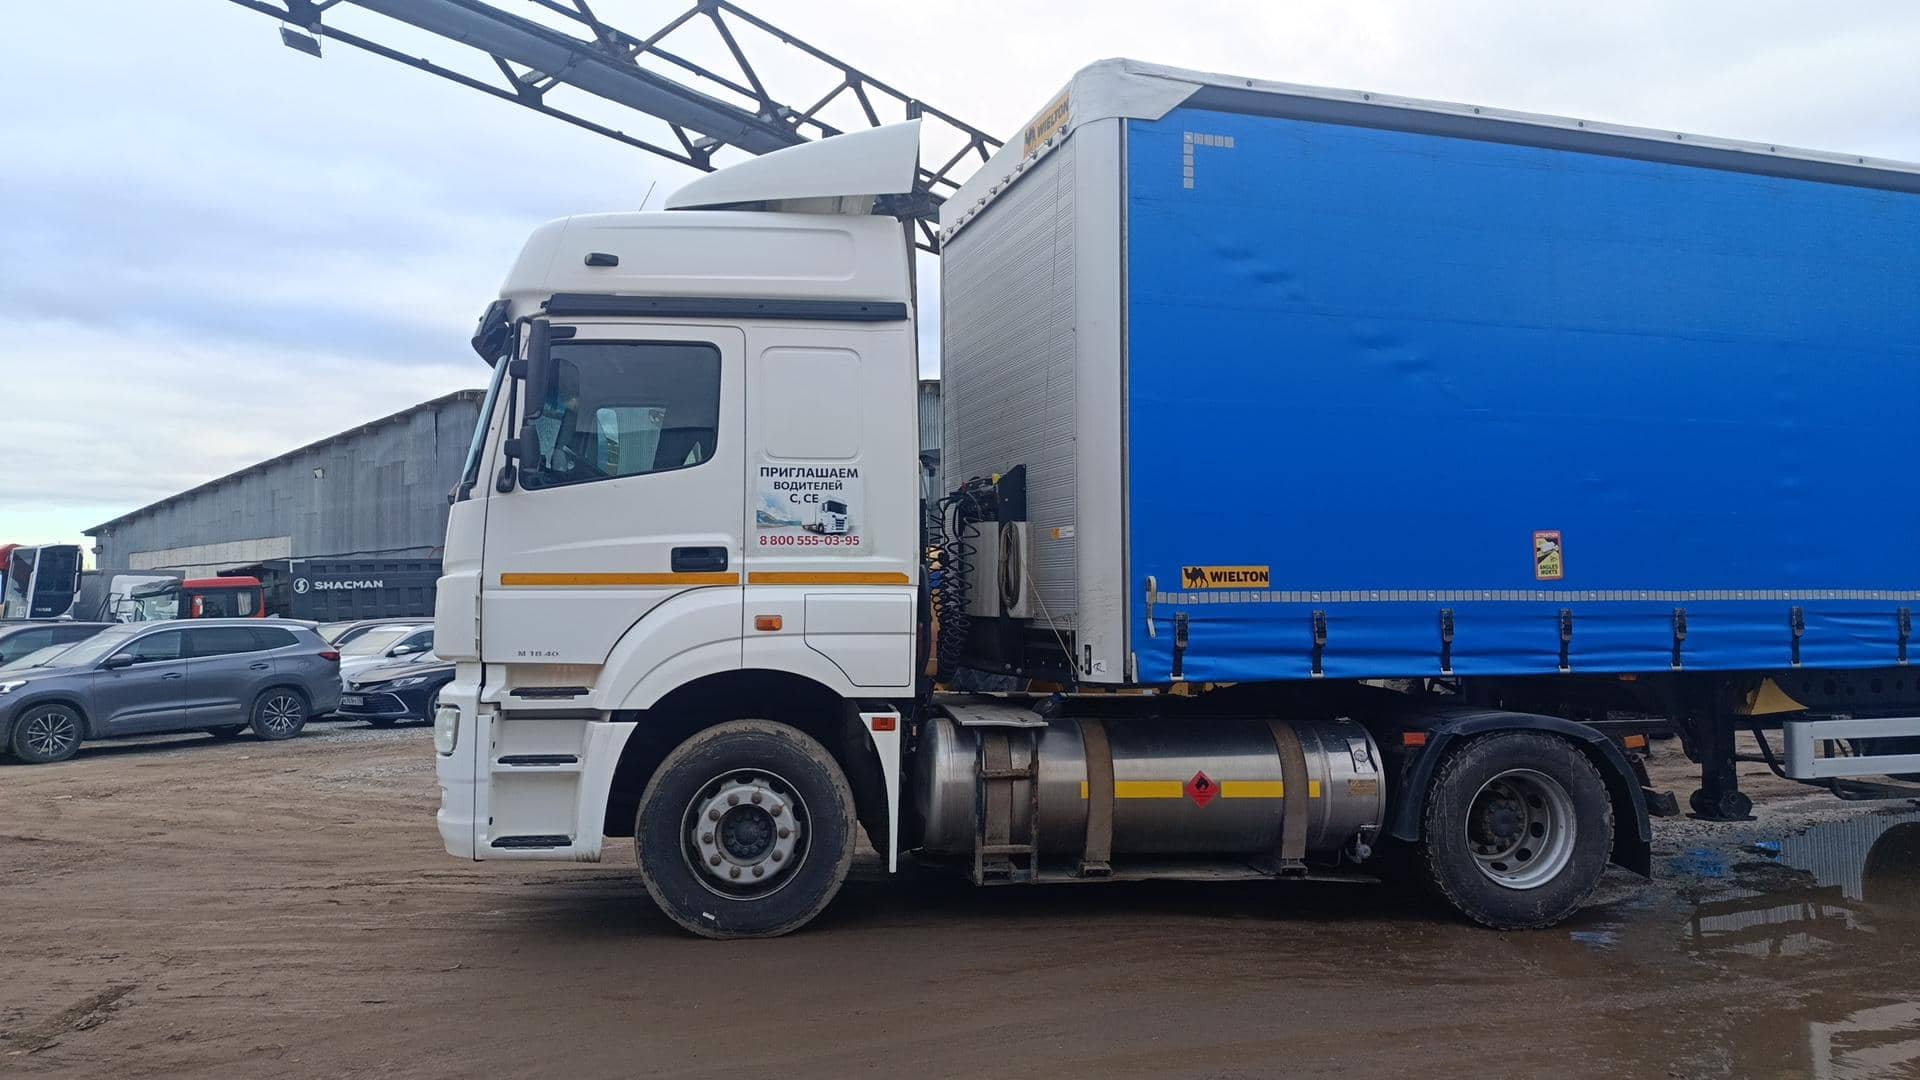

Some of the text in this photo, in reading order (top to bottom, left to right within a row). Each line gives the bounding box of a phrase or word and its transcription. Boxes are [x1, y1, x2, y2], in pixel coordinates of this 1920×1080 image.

[1036, 97, 1069, 138] WIELTON
[760, 467, 859, 478] ПРИГЛАШАЕМ
[774, 480, 843, 491] ВОДИТЕЛЕЙ
[760, 536, 859, 545] 8 800 555-03-95
[1210, 571, 1269, 582] WIELTON
[314, 580, 383, 589] SHACMAN
